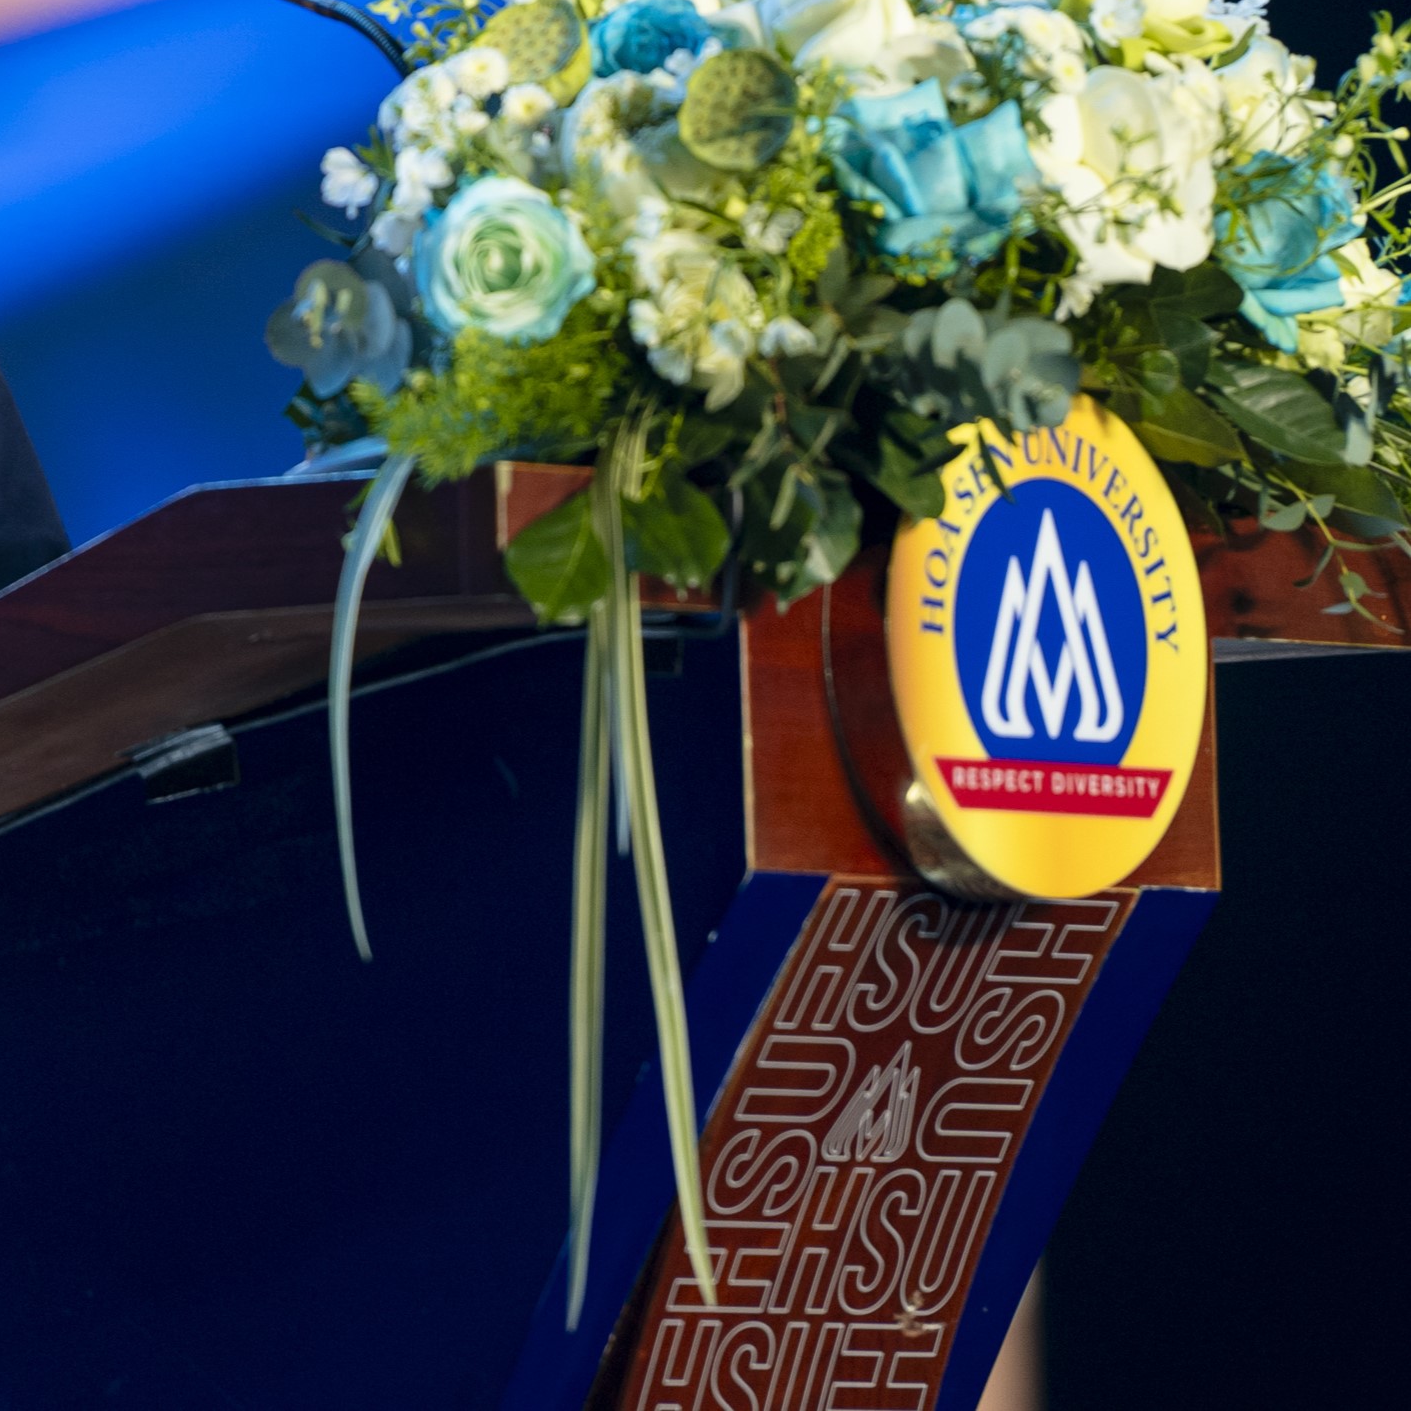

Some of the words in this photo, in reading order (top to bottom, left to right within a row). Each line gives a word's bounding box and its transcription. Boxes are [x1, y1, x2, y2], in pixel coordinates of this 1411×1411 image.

[920, 517, 962, 636] HOA
[1022, 426, 1180, 653] UNIVERSITY
[952, 765, 1045, 794] RESPECT
[1051, 771, 1160, 799] DIVERSITY
[774, 887, 1022, 1035] HSU
[916, 899, 1120, 1164] HSU
[665, 1034, 857, 1315] HSU
[768, 1165, 998, 1316] HSU
